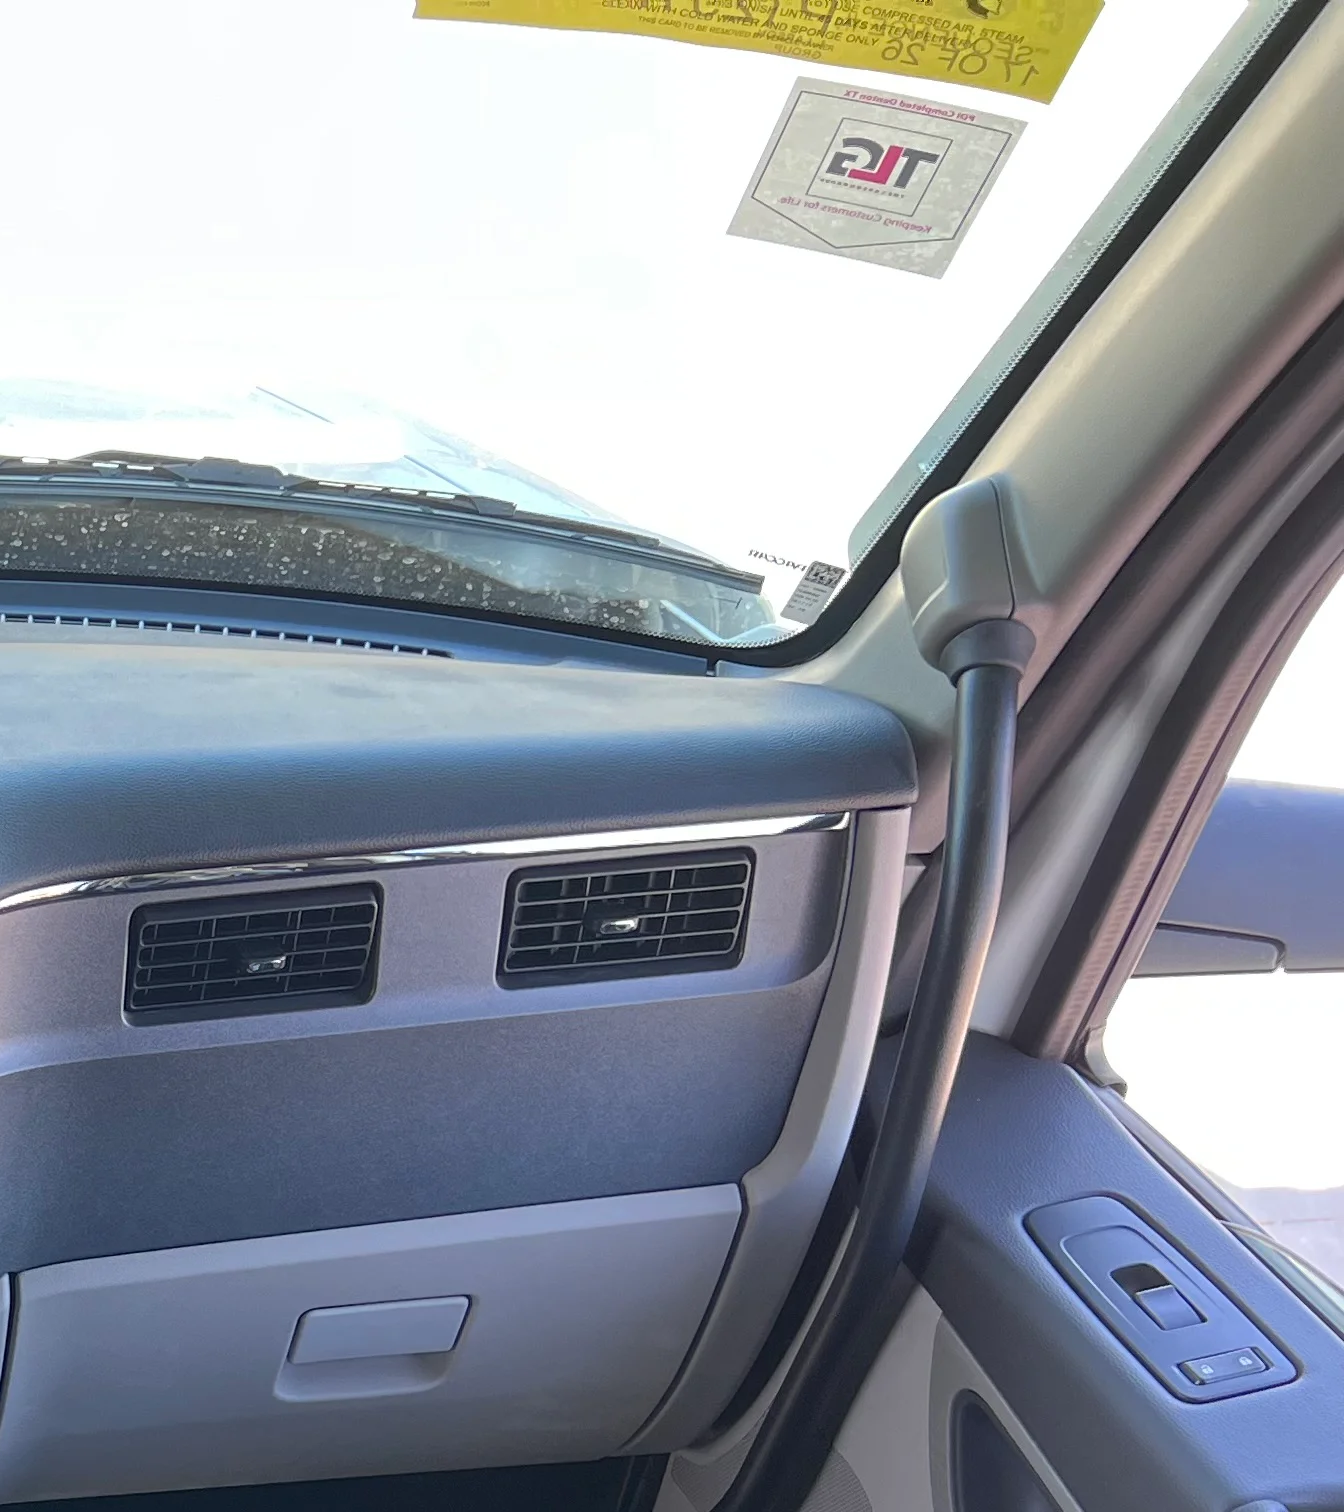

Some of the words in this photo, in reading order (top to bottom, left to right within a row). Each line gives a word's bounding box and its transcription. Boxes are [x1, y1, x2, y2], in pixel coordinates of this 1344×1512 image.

[657, 18, 683, 29] CARD
[679, 8, 714, 21] COLD
[761, 19, 789, 33] AND
[790, 25, 843, 42] SPONGE
[834, 16, 869, 31] DAYS
[862, 5, 951, 31] COMPRESSED
[980, 28, 1025, 45] STEAM
